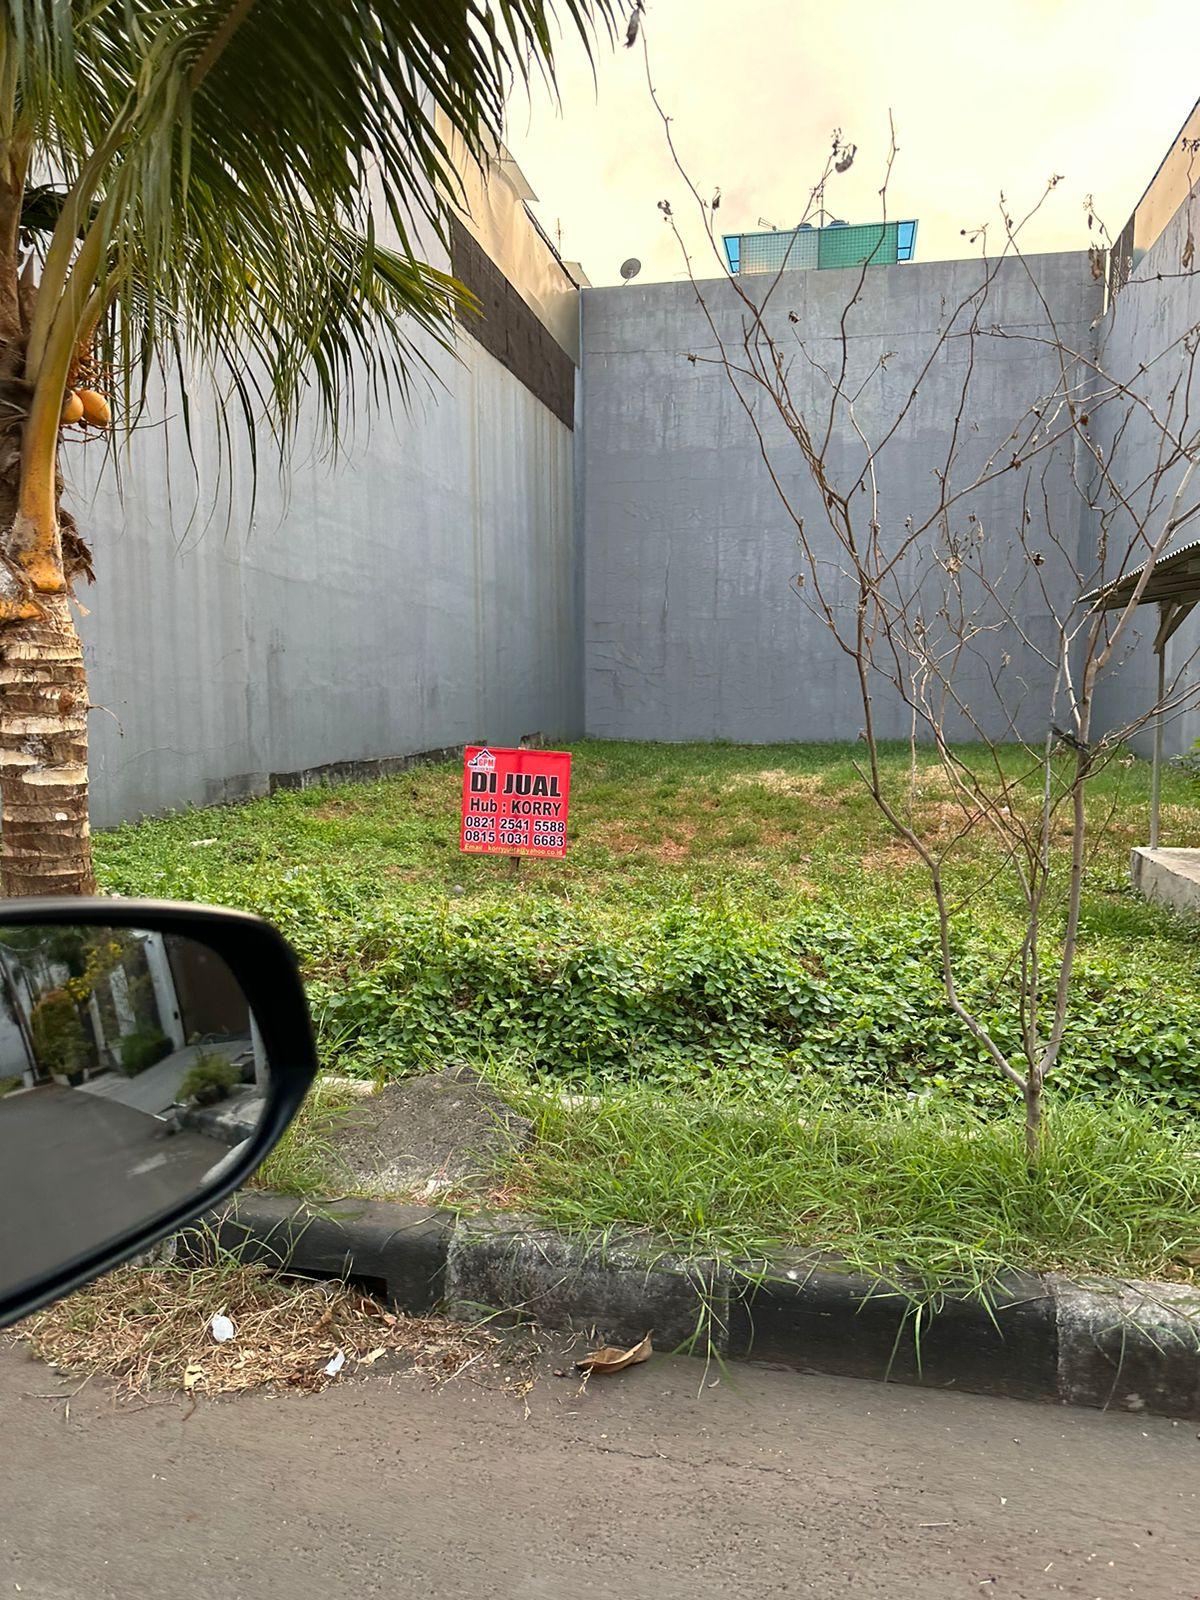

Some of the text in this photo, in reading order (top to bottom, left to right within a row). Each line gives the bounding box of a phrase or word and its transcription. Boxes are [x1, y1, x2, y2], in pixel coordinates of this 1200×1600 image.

[471, 771, 561, 797] DI JUAL
[470, 798, 498, 813] Hub
[511, 800, 562, 816] KORRY
[465, 816, 565, 833] 0821 2541 5588
[465, 830, 564, 847] 0815 1031 6683
